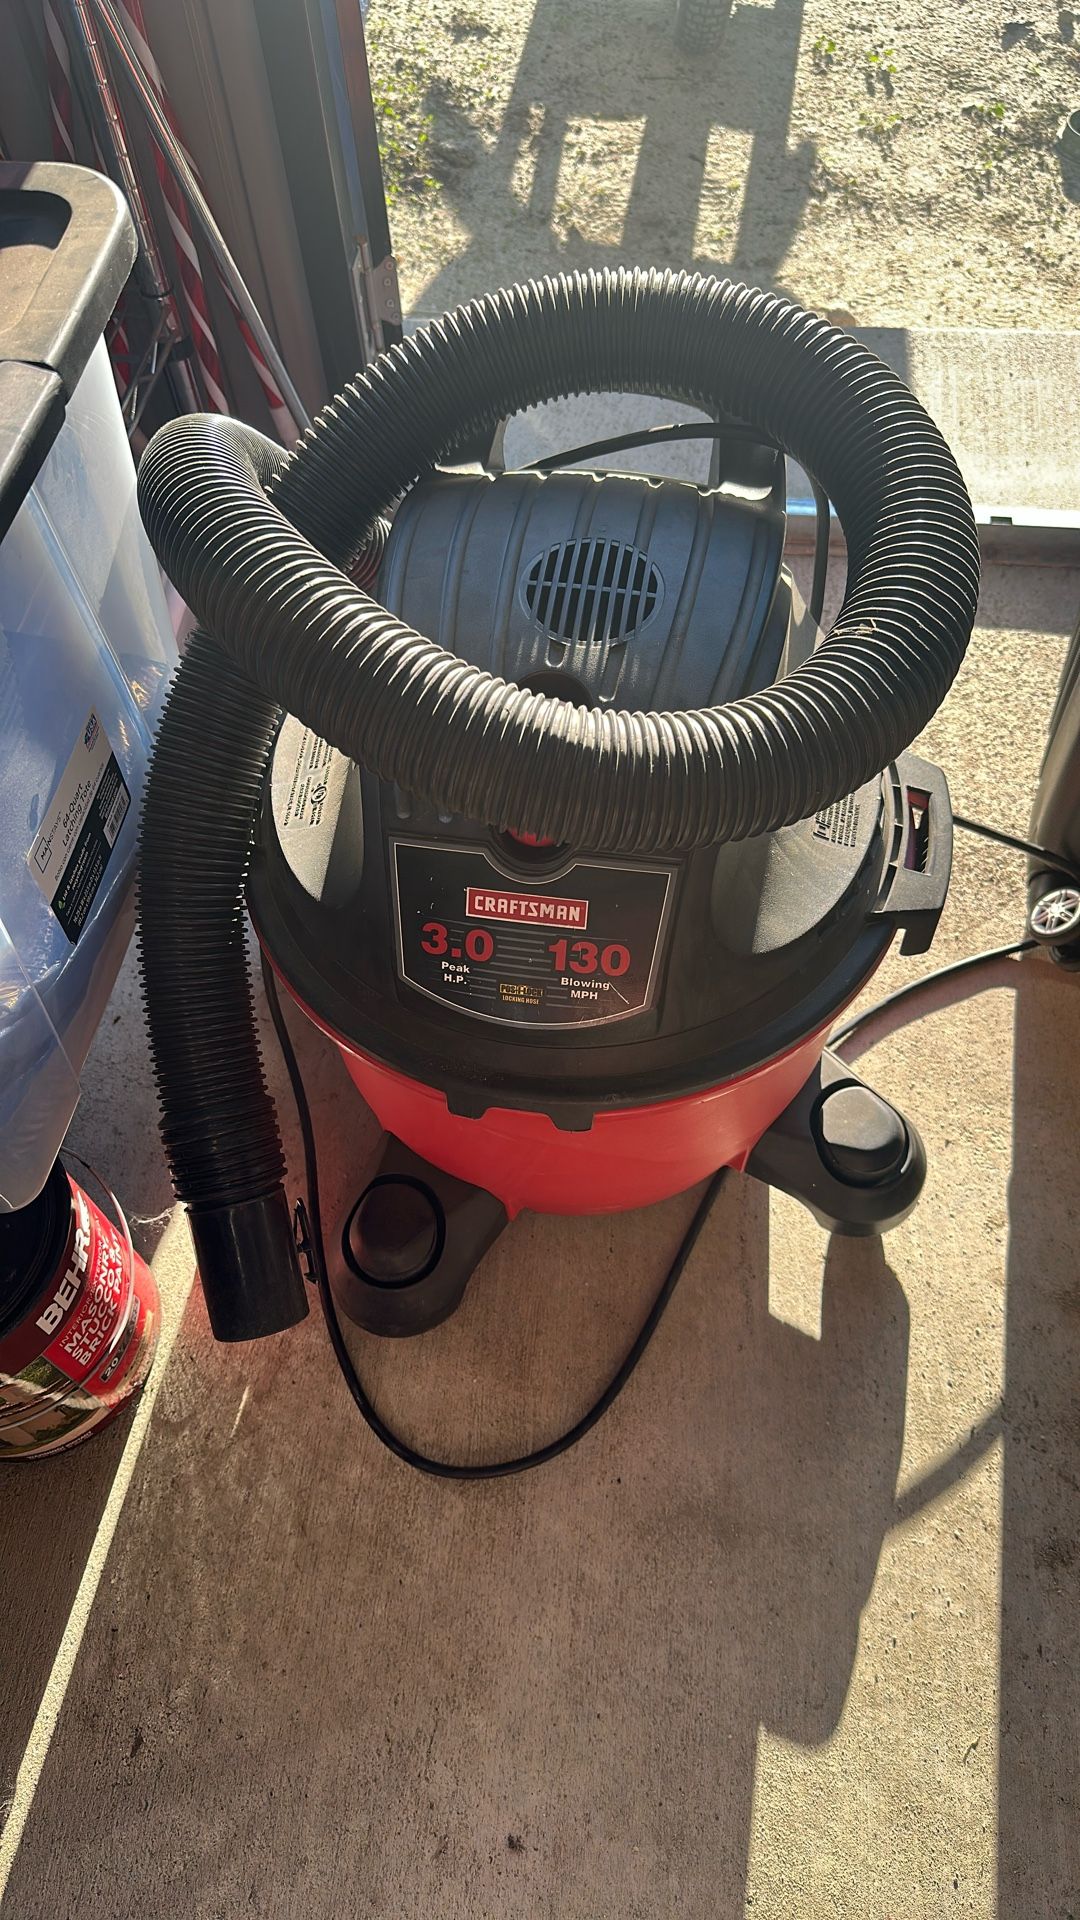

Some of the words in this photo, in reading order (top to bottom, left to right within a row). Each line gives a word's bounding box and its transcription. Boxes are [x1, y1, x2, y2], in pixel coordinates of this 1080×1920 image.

[62, 784, 84, 828] 64-Quart
[62, 807, 83, 847] Latching
[80, 780, 92, 807] Tote
[40, 811, 62, 861] MAINSTAYS
[474, 895, 581, 922] CRAFTSMAN
[420, 922, 494, 962] 3.0
[549, 939, 631, 977] 130
[441, 961, 470, 974] Peak
[444, 973, 468, 985] H.P.
[561, 977, 610, 991] Blowing
[502, 994, 525, 1003] LOCKING
[570, 990, 598, 1000] MPH
[36, 1228, 90, 1335] BEHR
[72, 1268, 115, 1360] STUCCO
[79, 1299, 117, 1366] BRICK
[105, 1357, 119, 1377] 20
